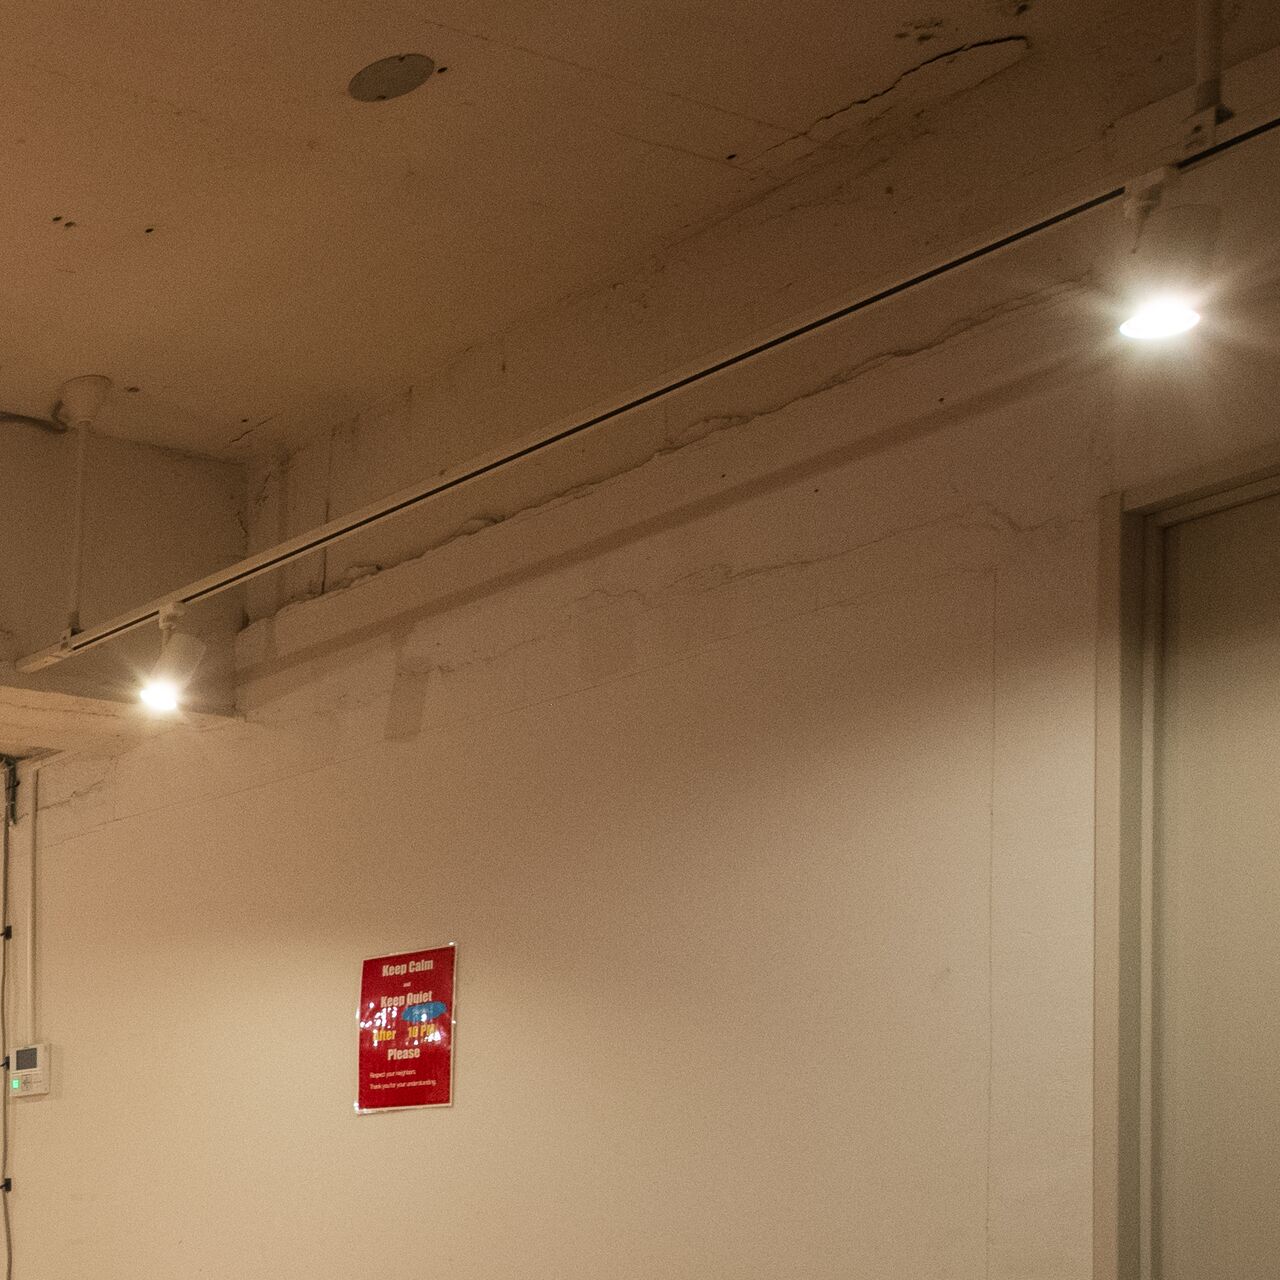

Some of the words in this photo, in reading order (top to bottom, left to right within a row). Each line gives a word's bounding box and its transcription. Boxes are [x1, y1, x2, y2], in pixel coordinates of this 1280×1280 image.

[382, 964, 407, 977] Keep
[408, 959, 434, 973] Calm
[380, 995, 405, 1008] Keep
[406, 990, 433, 1005] Quiet
[408, 1025, 419, 1038] 10
[387, 1047, 421, 1061] Please
